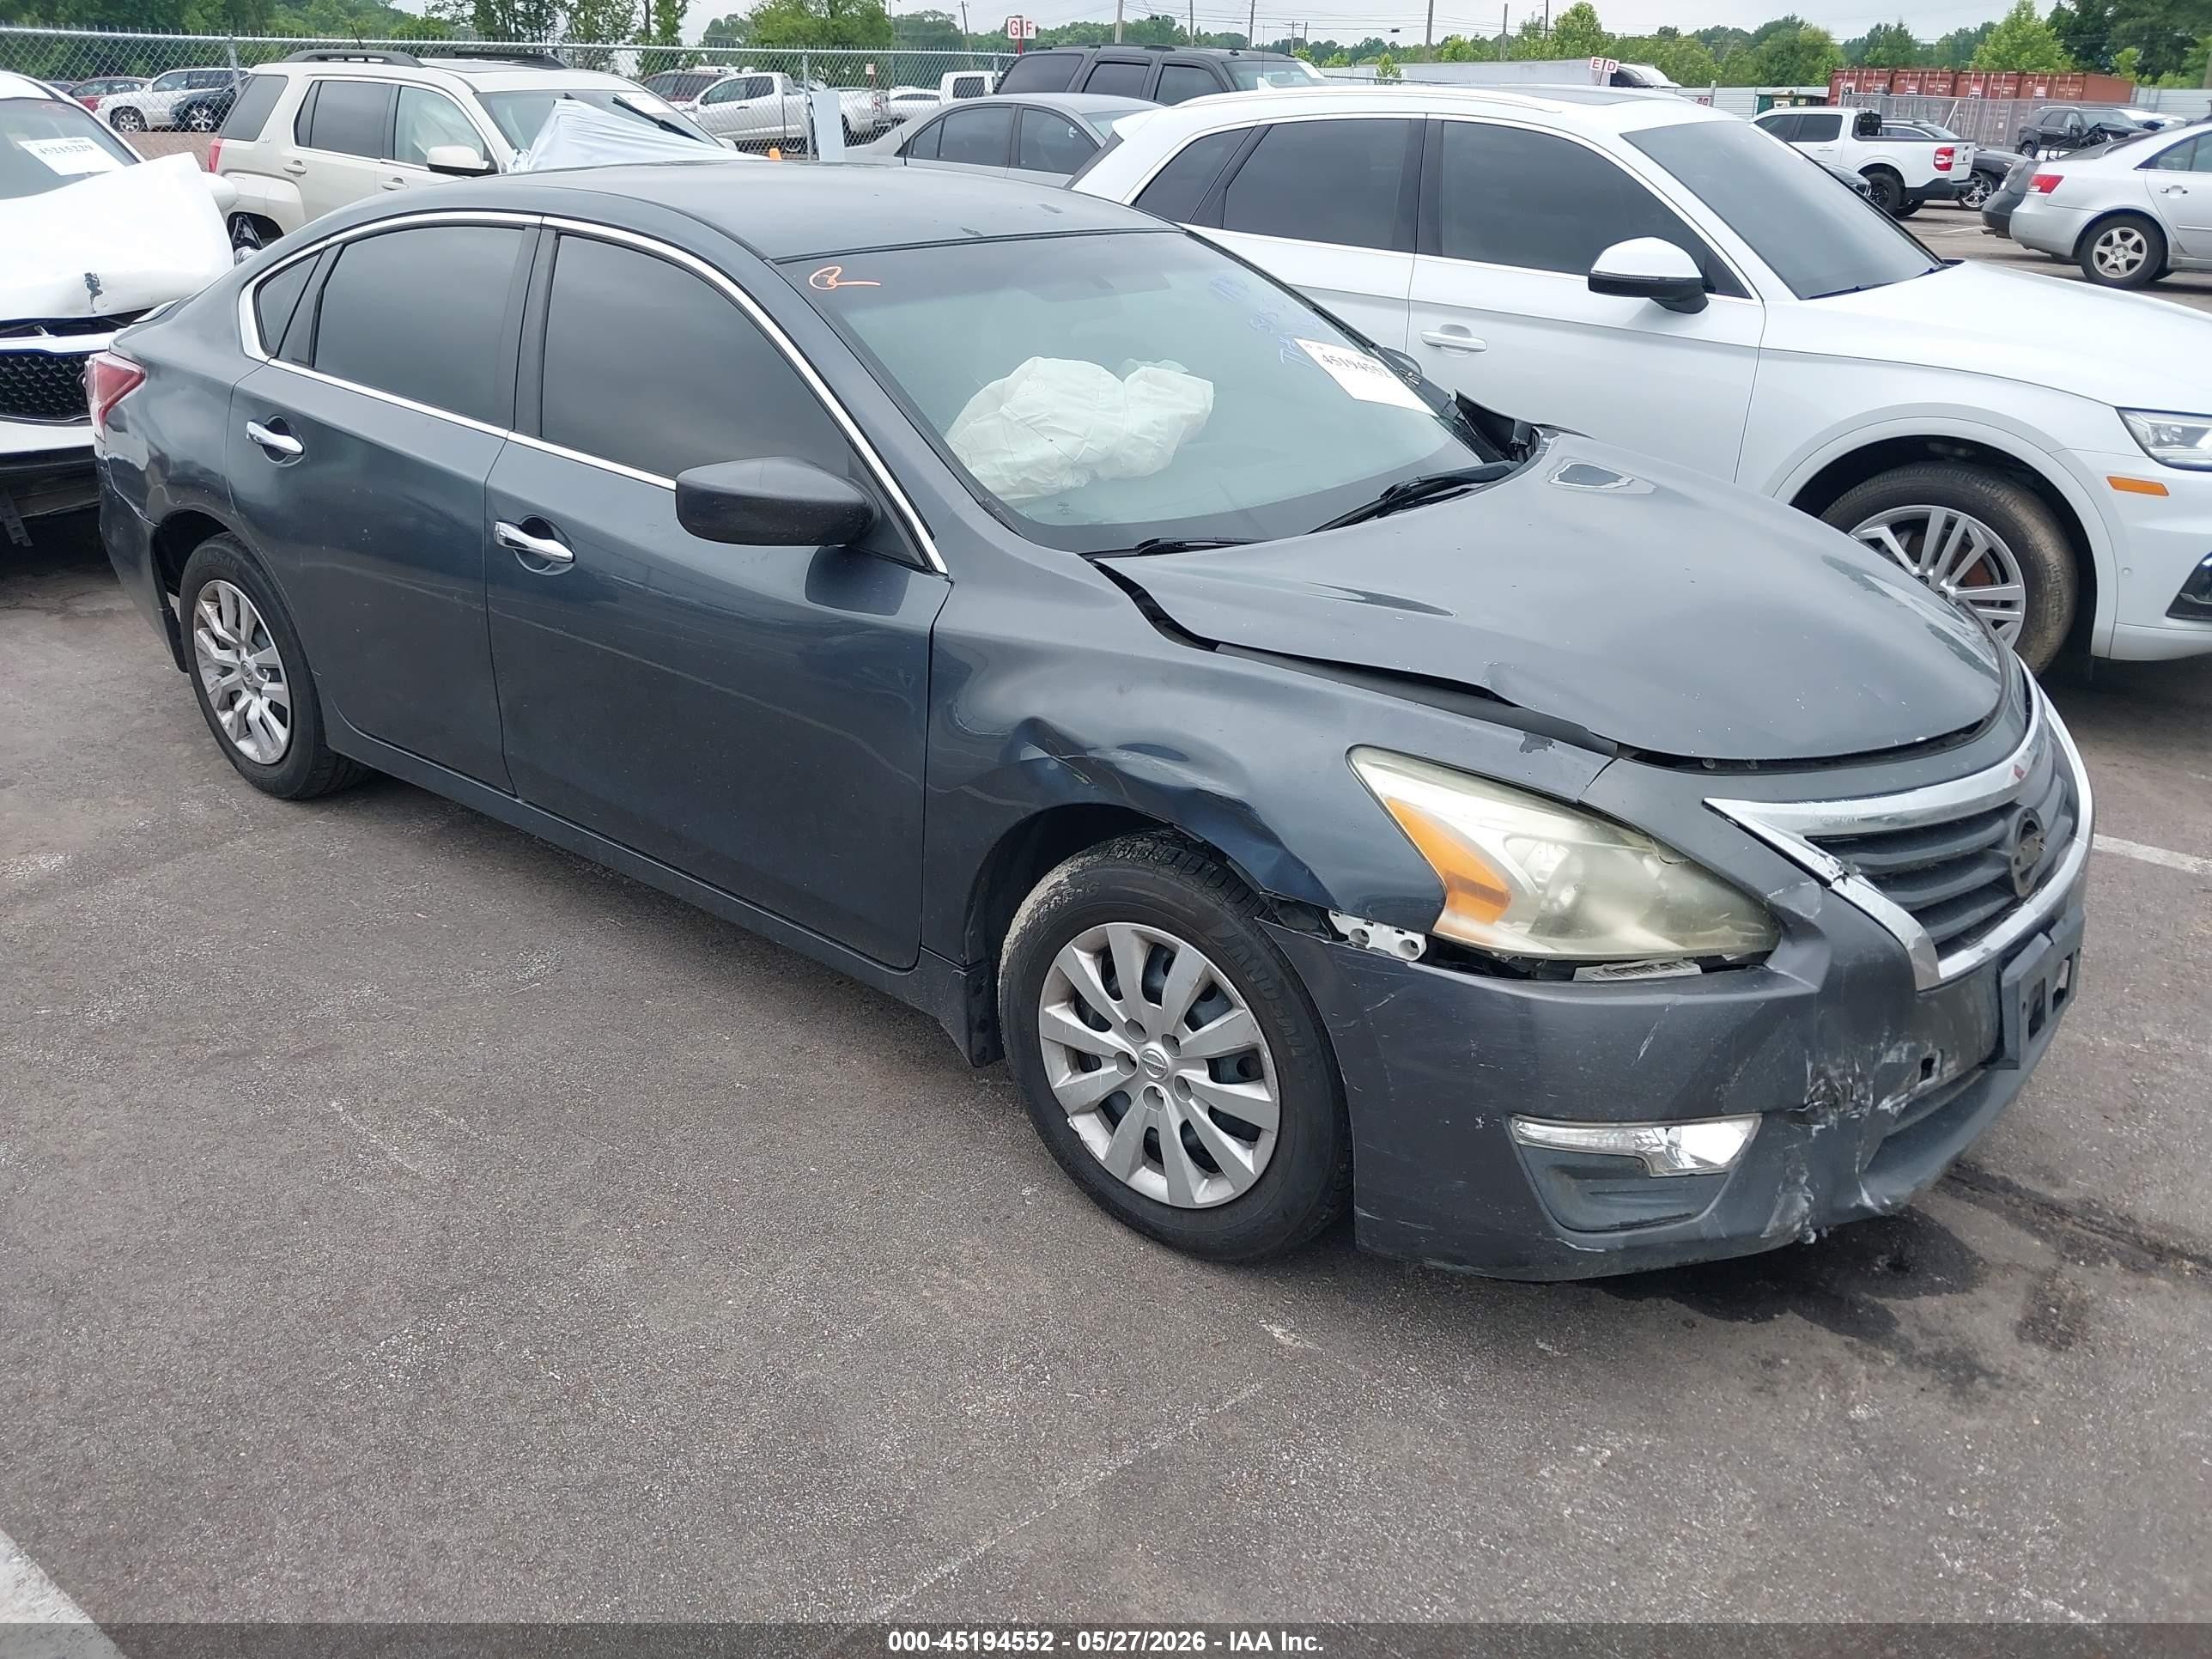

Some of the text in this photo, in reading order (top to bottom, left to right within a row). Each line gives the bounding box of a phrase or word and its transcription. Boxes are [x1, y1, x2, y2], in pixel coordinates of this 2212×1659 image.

[1010, 20, 1032, 35] G F
[1592, 58, 1616, 70] E D
